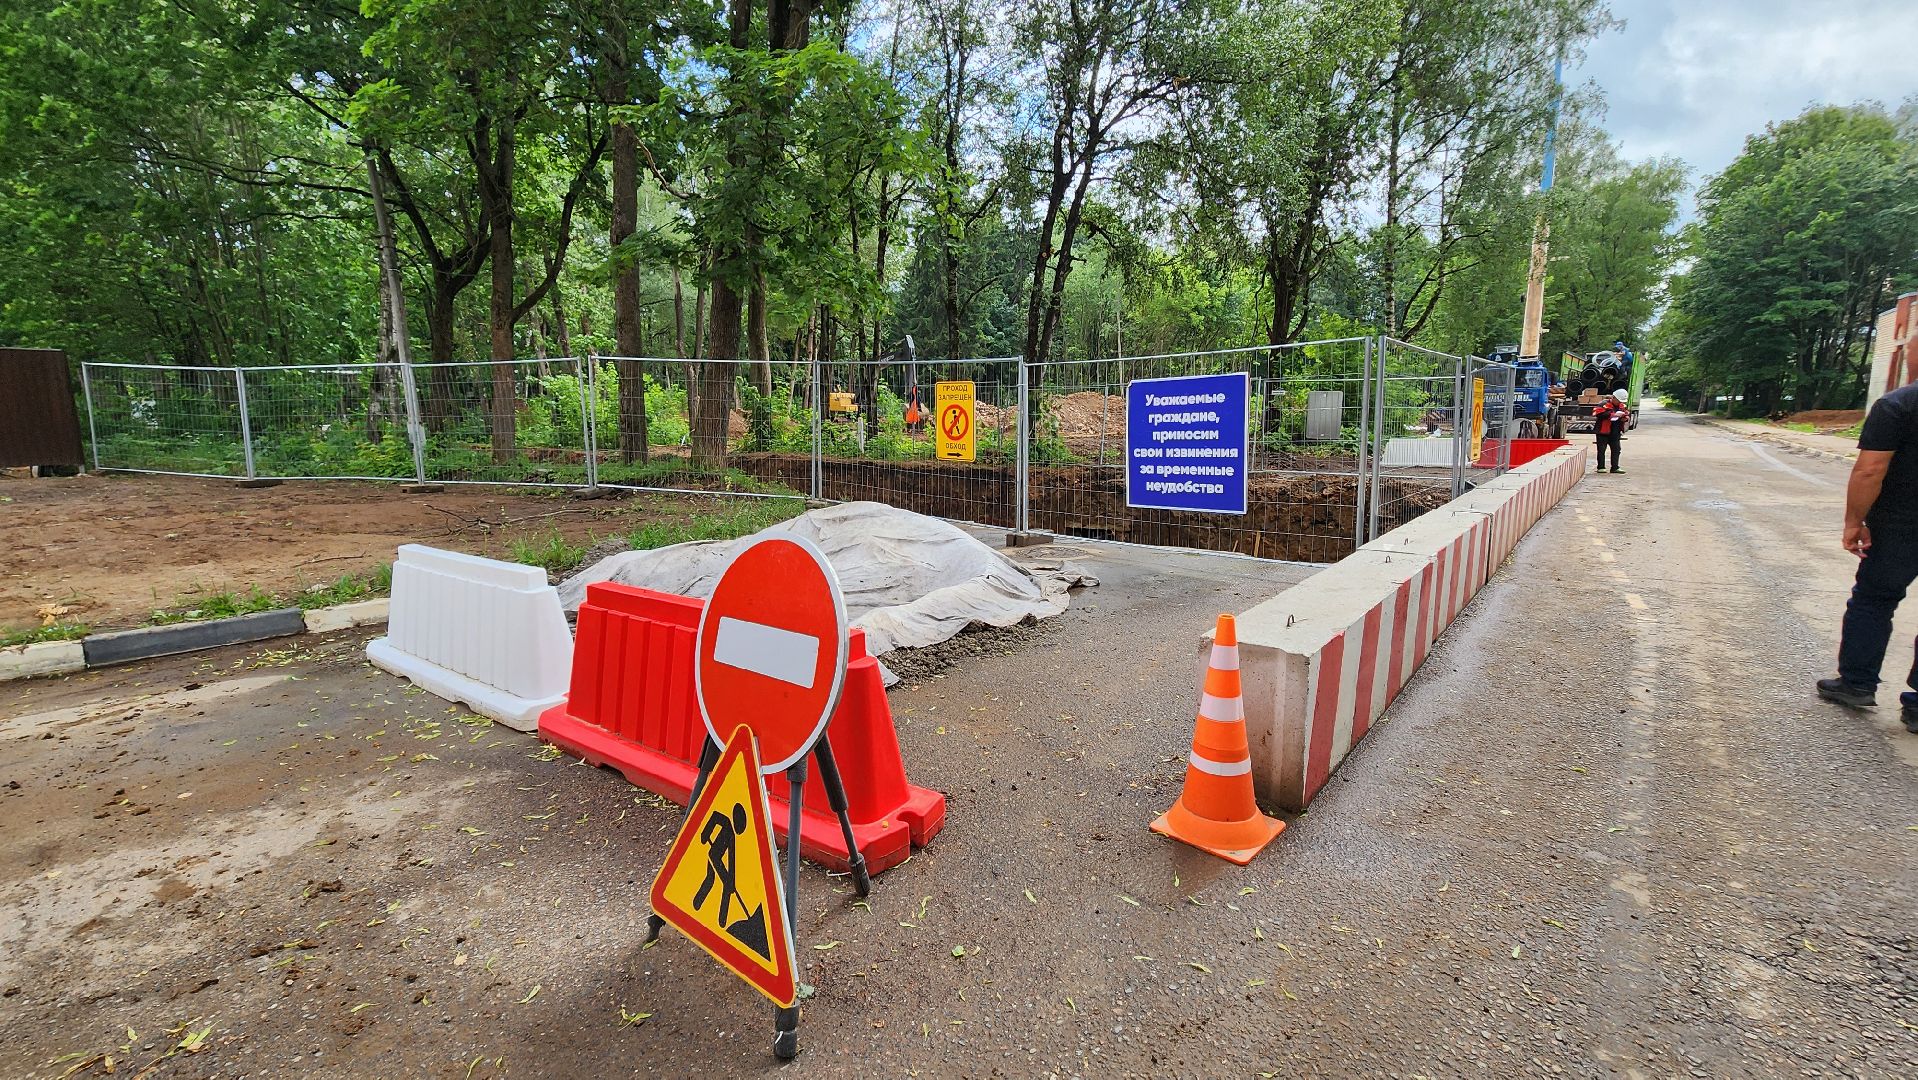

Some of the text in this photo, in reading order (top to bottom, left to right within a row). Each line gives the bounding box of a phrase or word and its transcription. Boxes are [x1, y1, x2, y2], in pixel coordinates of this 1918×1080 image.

[1145, 393, 1226, 406] Уважаемые
[1148, 411, 1221, 426] граждане,
[1153, 430, 1219, 443] приносим
[1133, 448, 1239, 458] свои извинения
[1139, 465, 1235, 477] за временные
[1145, 480, 1224, 494] неудобства
